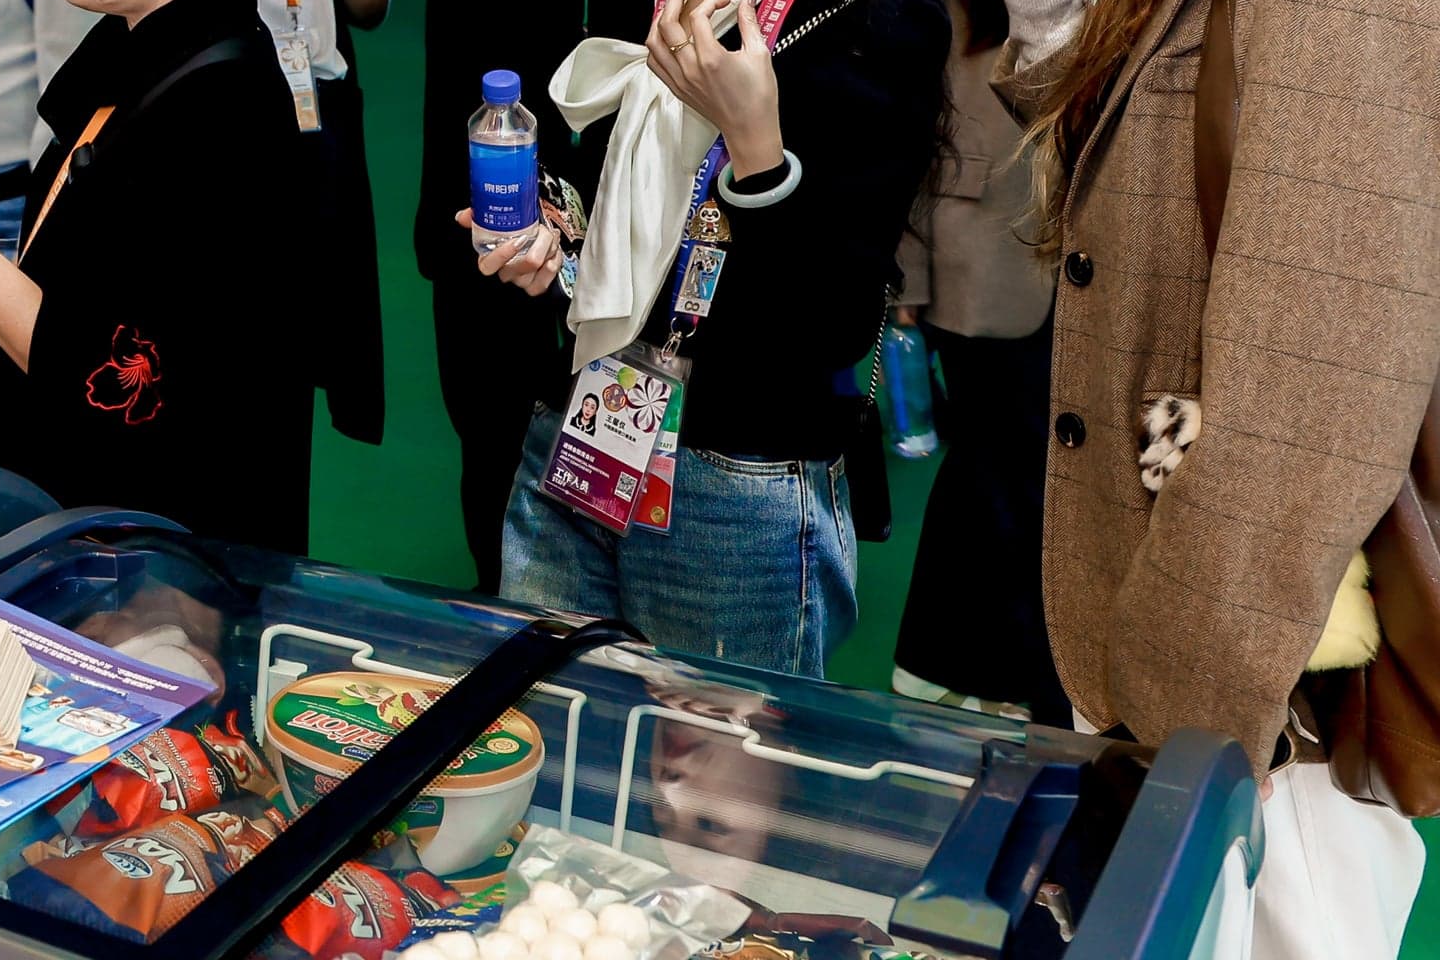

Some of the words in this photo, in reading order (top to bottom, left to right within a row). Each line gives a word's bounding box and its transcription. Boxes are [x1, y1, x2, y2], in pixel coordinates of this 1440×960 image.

[553, 466, 590, 494] 工作人员
[286, 710, 396, 752] ation
